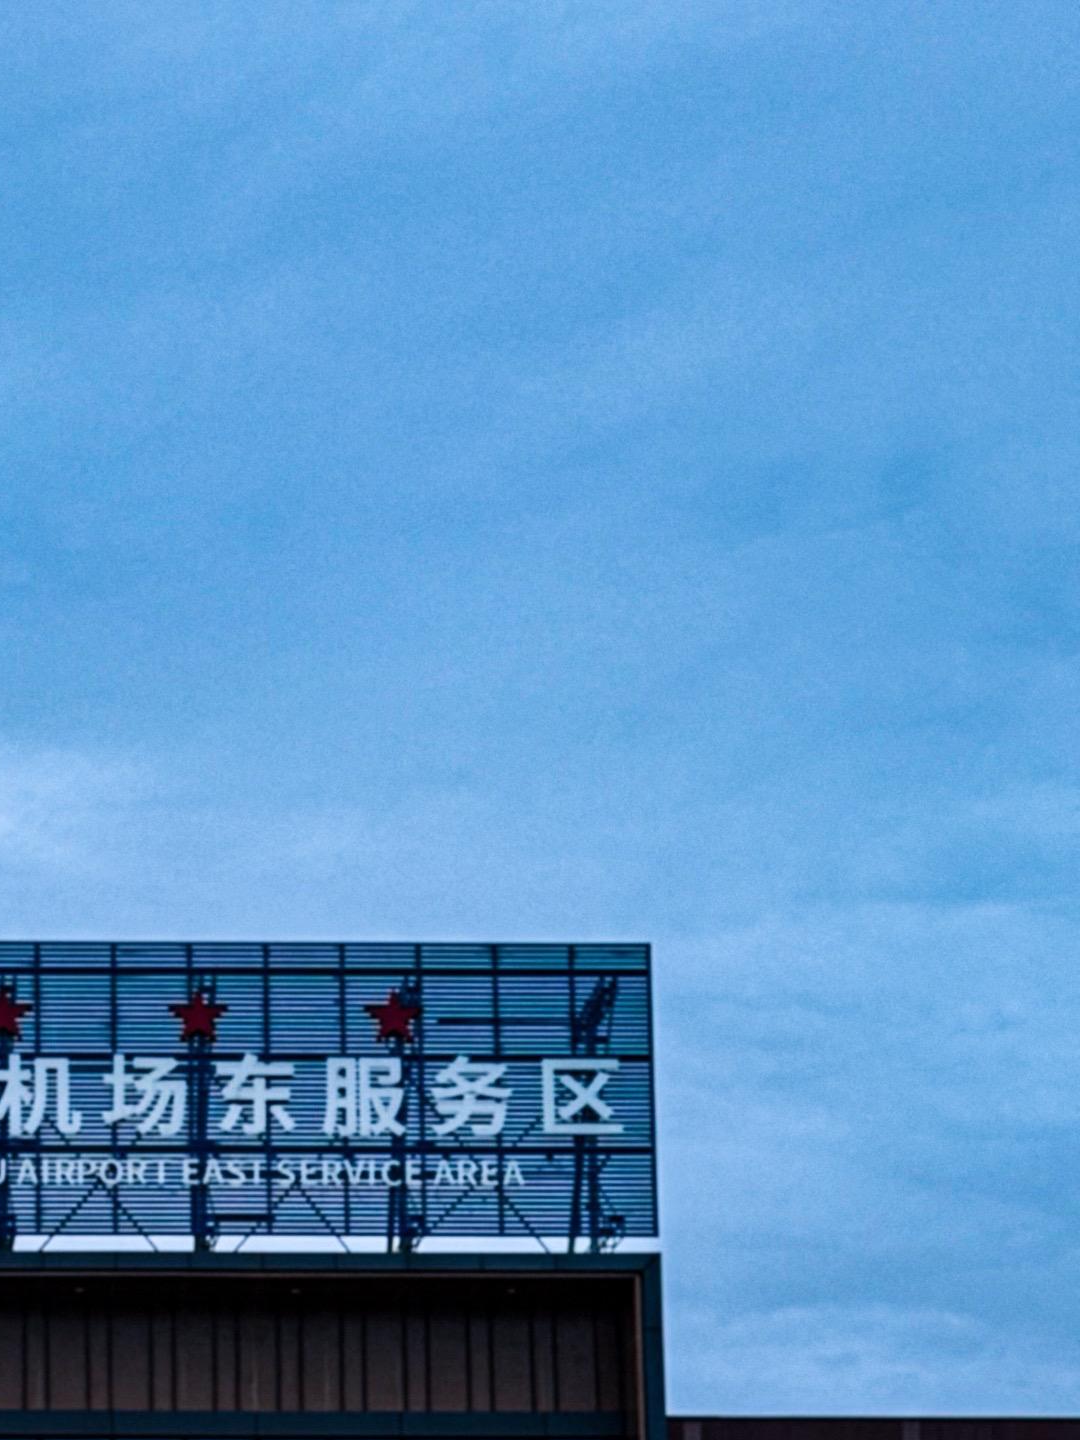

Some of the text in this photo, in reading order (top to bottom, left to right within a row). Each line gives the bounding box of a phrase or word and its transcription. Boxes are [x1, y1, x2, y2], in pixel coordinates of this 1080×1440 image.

[14, 1158, 169, 1186] AIRPORT
[182, 1158, 266, 1186] EAST
[273, 1159, 422, 1187] SERVICE
[432, 1159, 526, 1187] AREA
